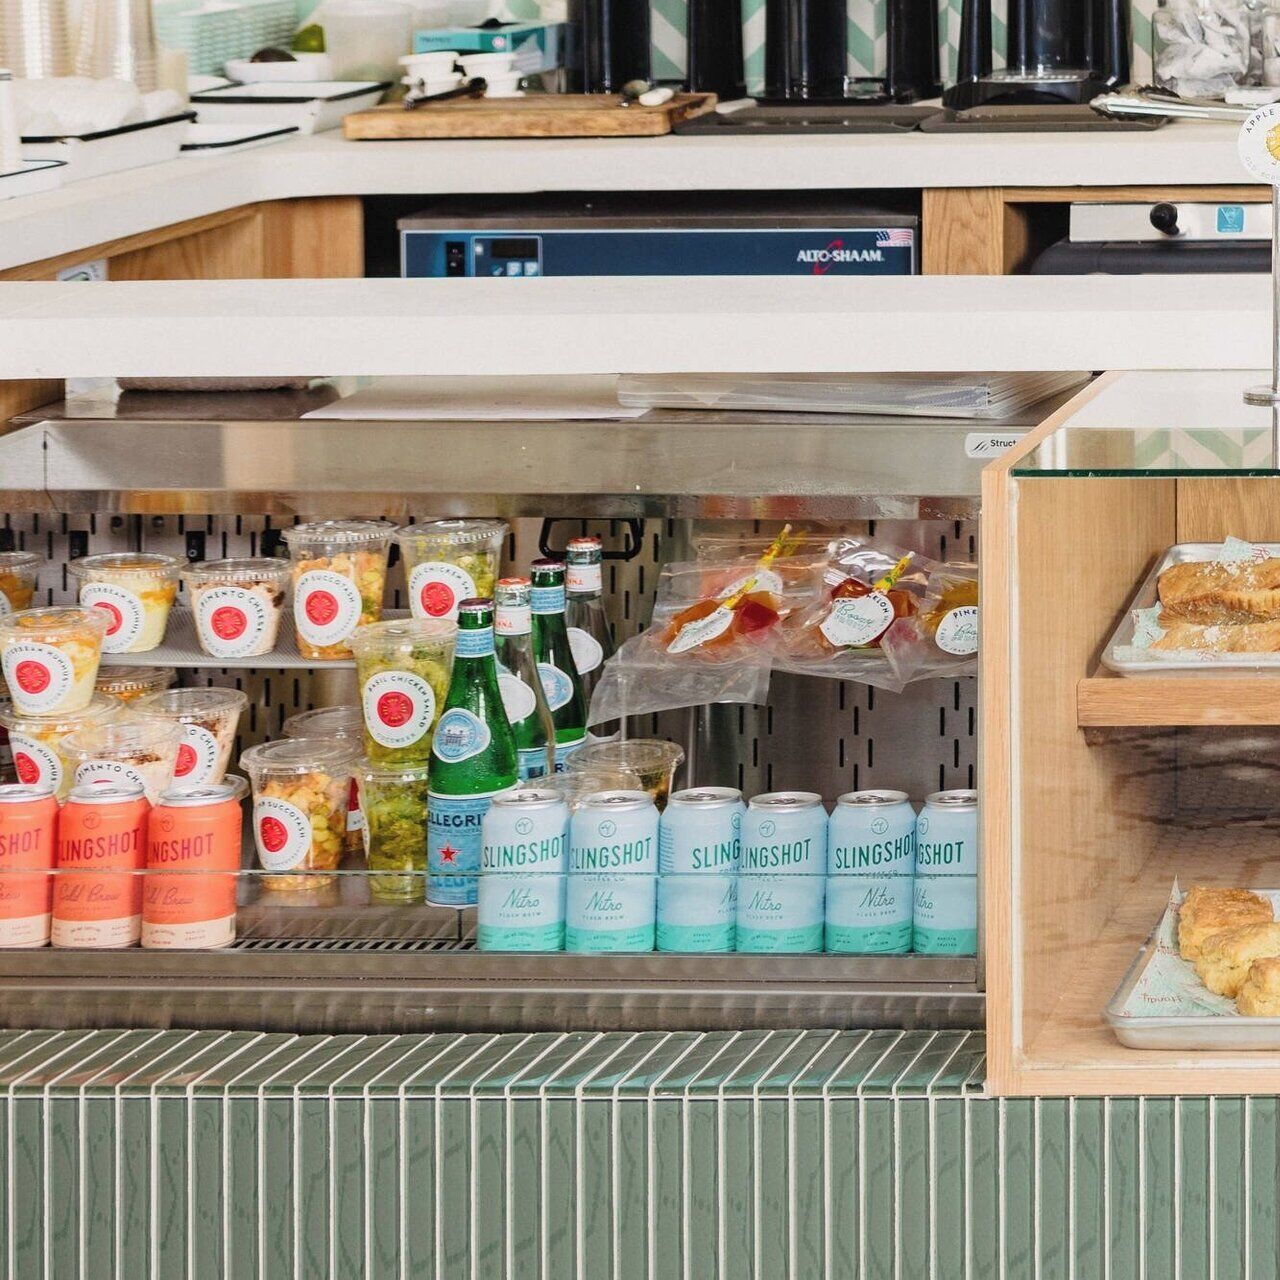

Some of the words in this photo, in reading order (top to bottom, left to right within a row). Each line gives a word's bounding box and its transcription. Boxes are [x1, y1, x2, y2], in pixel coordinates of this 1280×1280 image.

[1246, 108, 1275, 134] APPLE
[796, 248, 882, 262] ALTO-SHAAM
[200, 589, 246, 608] PIMENTO
[248, 596, 265, 633] CHEESE
[368, 677, 389, 693] BASIL
[390, 675, 428, 698] CHICKEN
[420, 698, 431, 729] SALAD
[37, 747, 58, 782] HUMMUS
[77, 763, 122, 781] PIMENTO
[266, 800, 306, 839] SUCCOTASH
[483, 833, 566, 868] SLINGSHOT
[835, 829, 914, 869] SLINGSHOT
[502, 887, 540, 909] Nitro
[584, 890, 623, 912] Nitro
[748, 890, 782, 912] Nitro
[858, 886, 896, 909] Nitro
